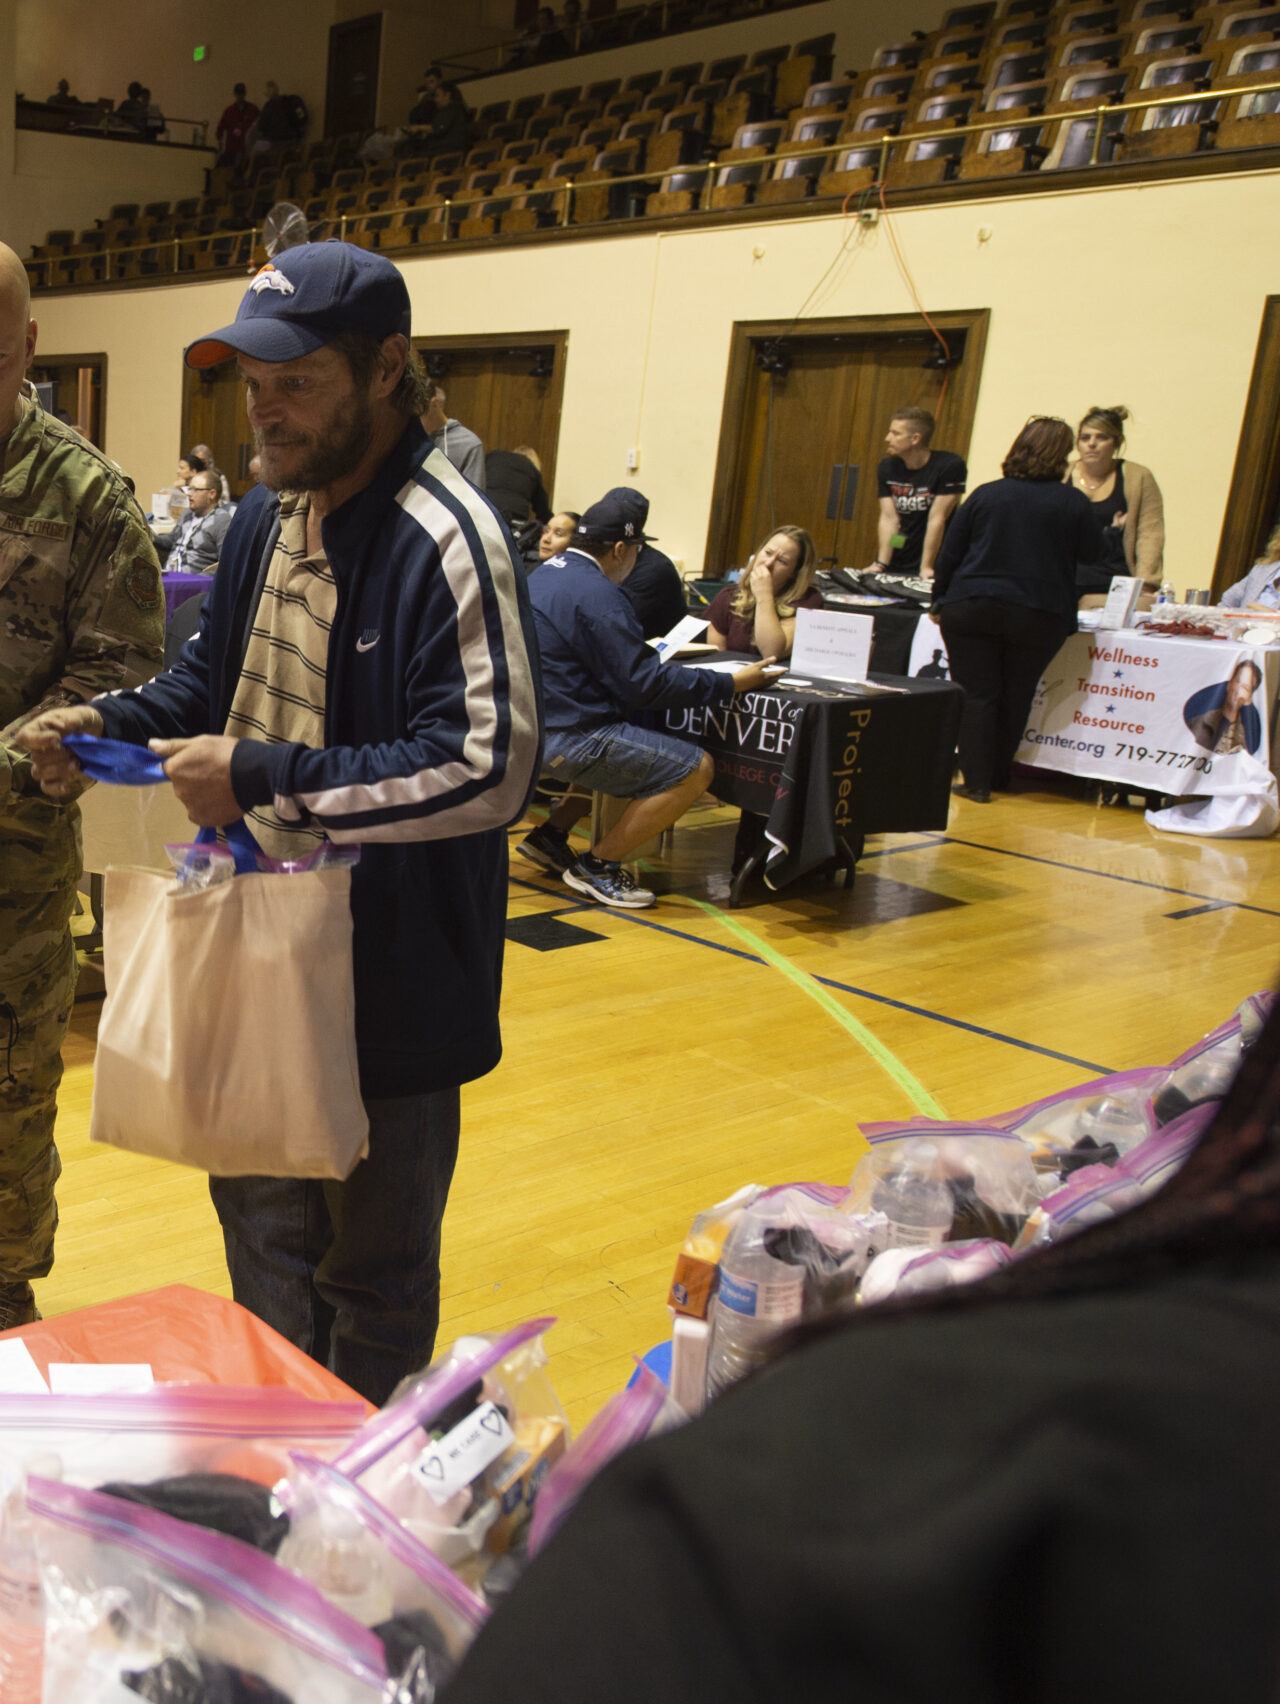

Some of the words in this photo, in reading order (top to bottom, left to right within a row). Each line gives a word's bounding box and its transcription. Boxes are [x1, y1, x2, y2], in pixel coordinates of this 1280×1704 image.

[4, 515, 23, 530] AIR
[27, 520, 65, 539] FORCE
[1087, 645, 1159, 668] Wellness
[1076, 677, 1156, 702] Transition
[787, 706, 804, 722] of
[1072, 710, 1145, 735] Resource
[665, 704, 796, 755] DENVER
[1021, 728, 1106, 758] Center.org
[717, 761, 765, 785] OLLEGE
[832, 708, 872, 827] Project
